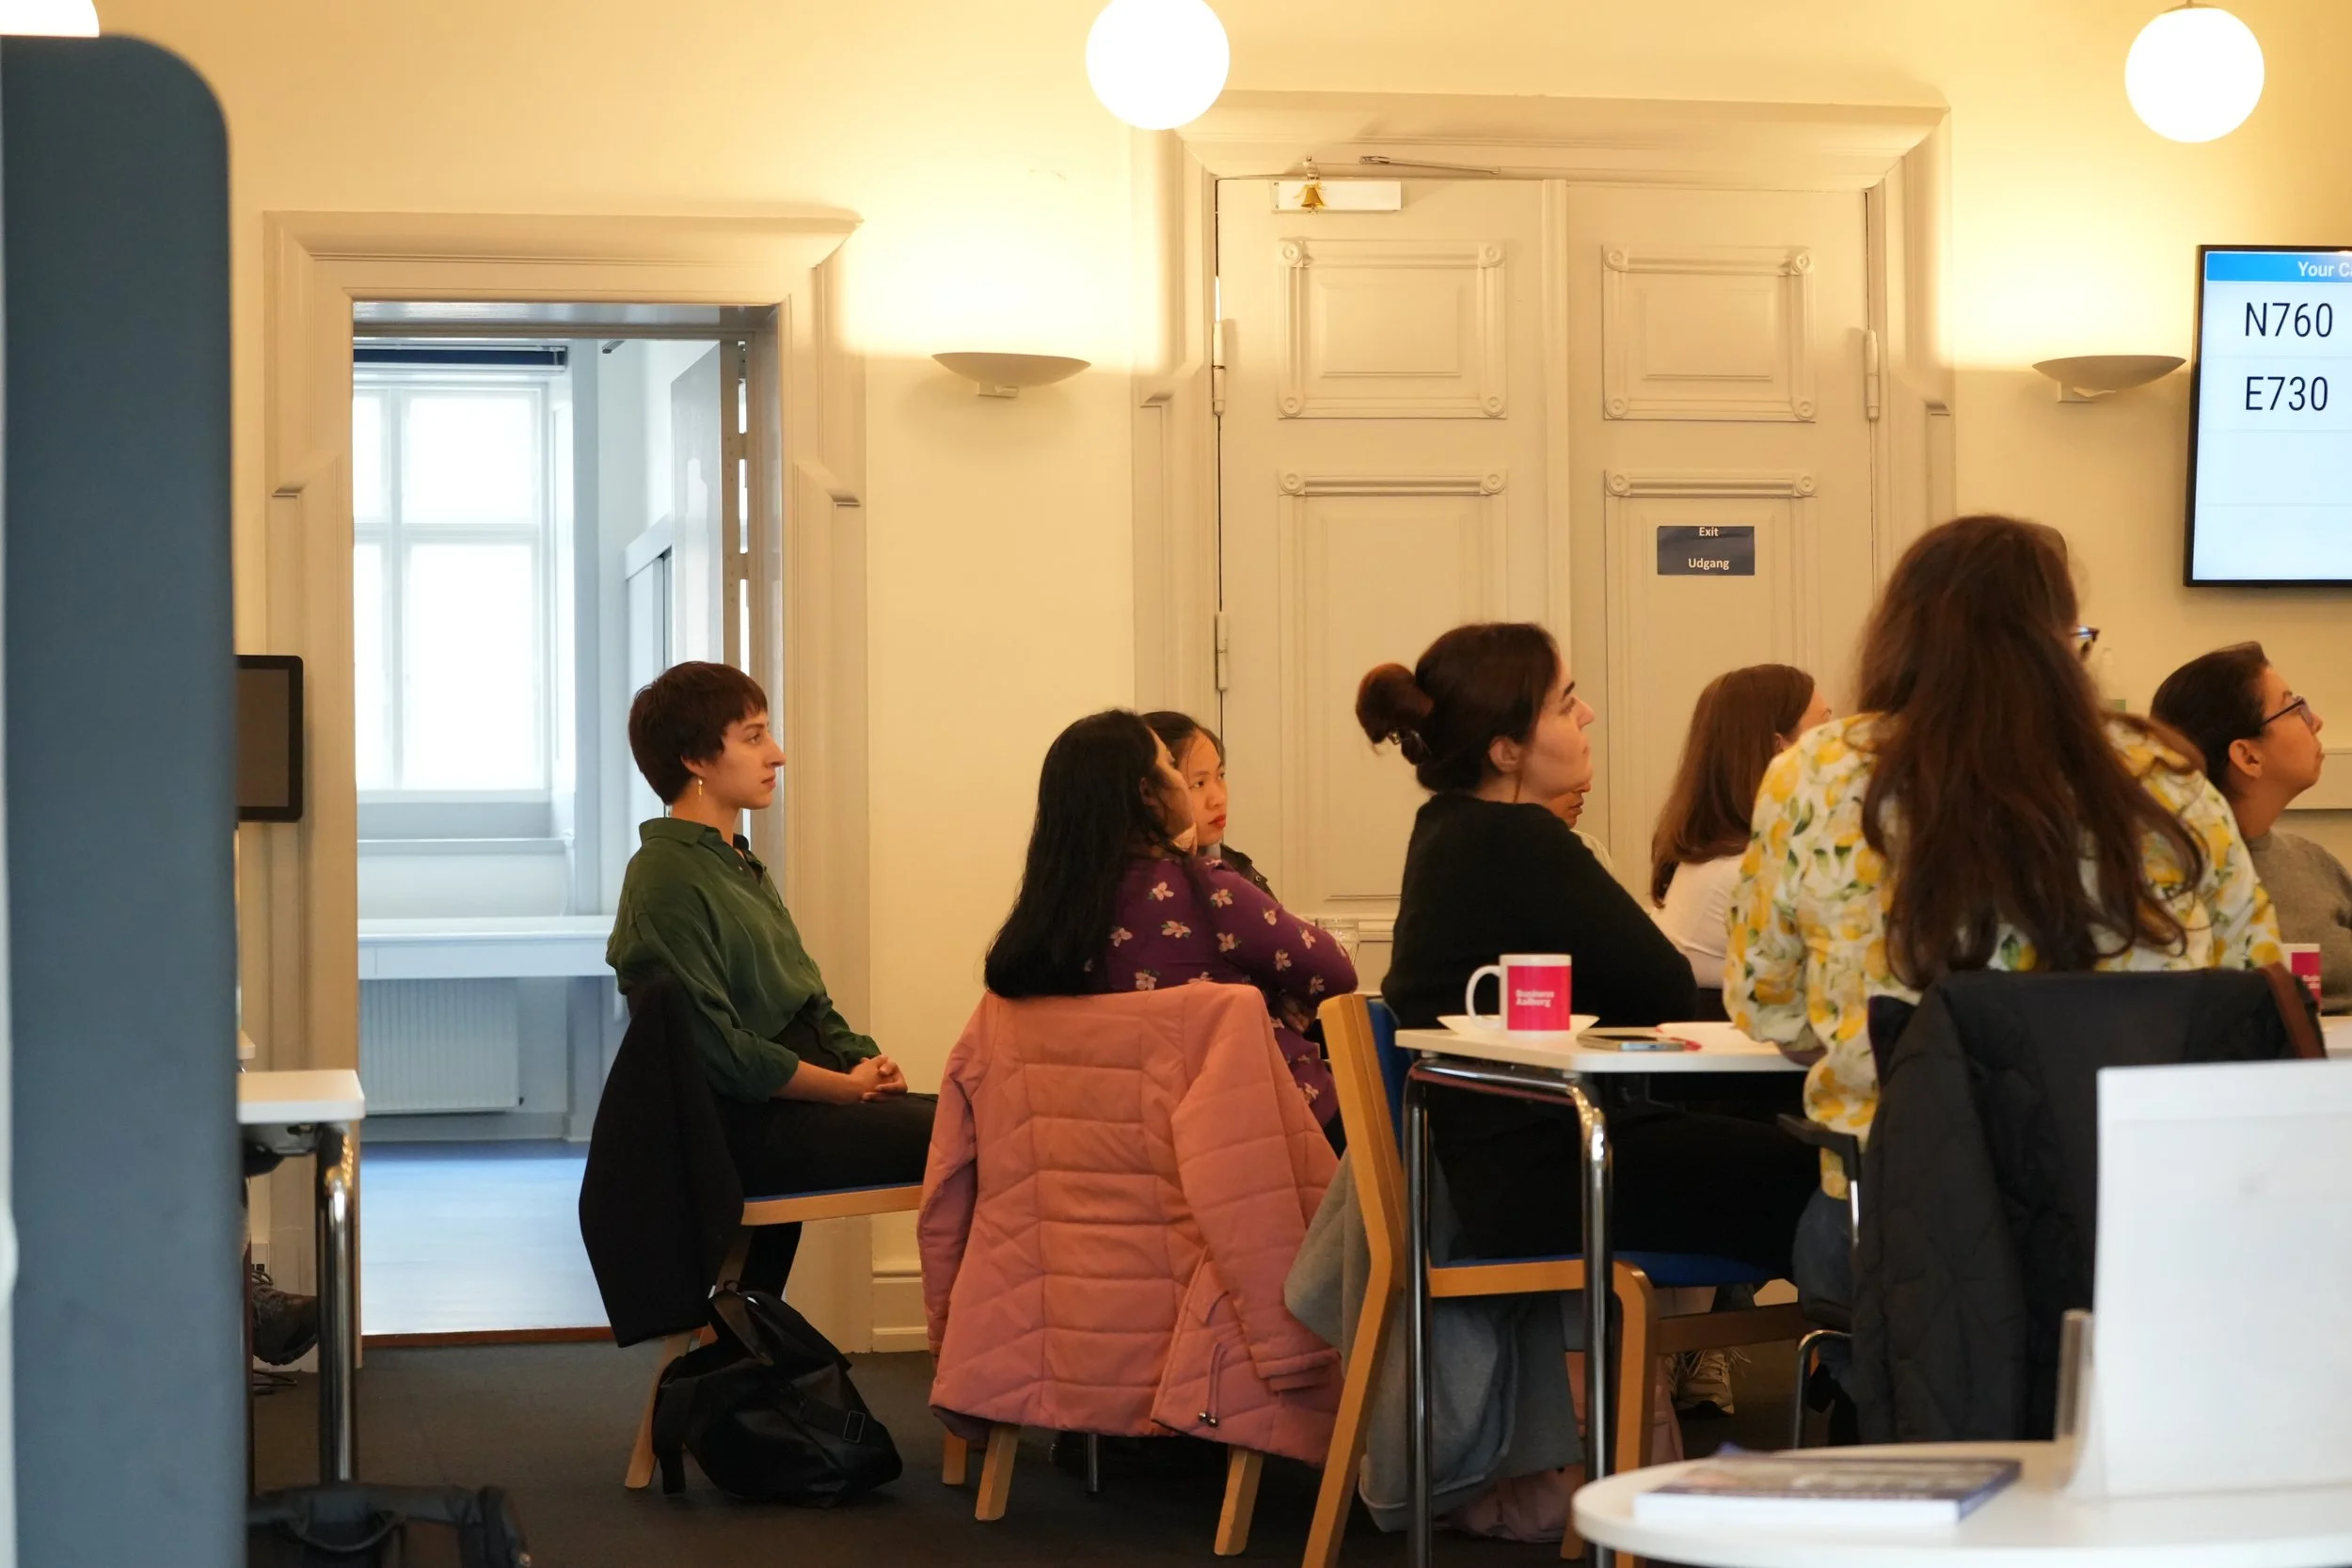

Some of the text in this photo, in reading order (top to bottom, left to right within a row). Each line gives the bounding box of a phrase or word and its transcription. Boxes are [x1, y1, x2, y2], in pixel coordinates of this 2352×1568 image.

[2297, 261, 2335, 277] Your
[2245, 302, 2333, 338] N760
[2245, 375, 2328, 411] E730
[1699, 527, 1719, 537] Exit
[1688, 558, 1729, 570] Udgang
